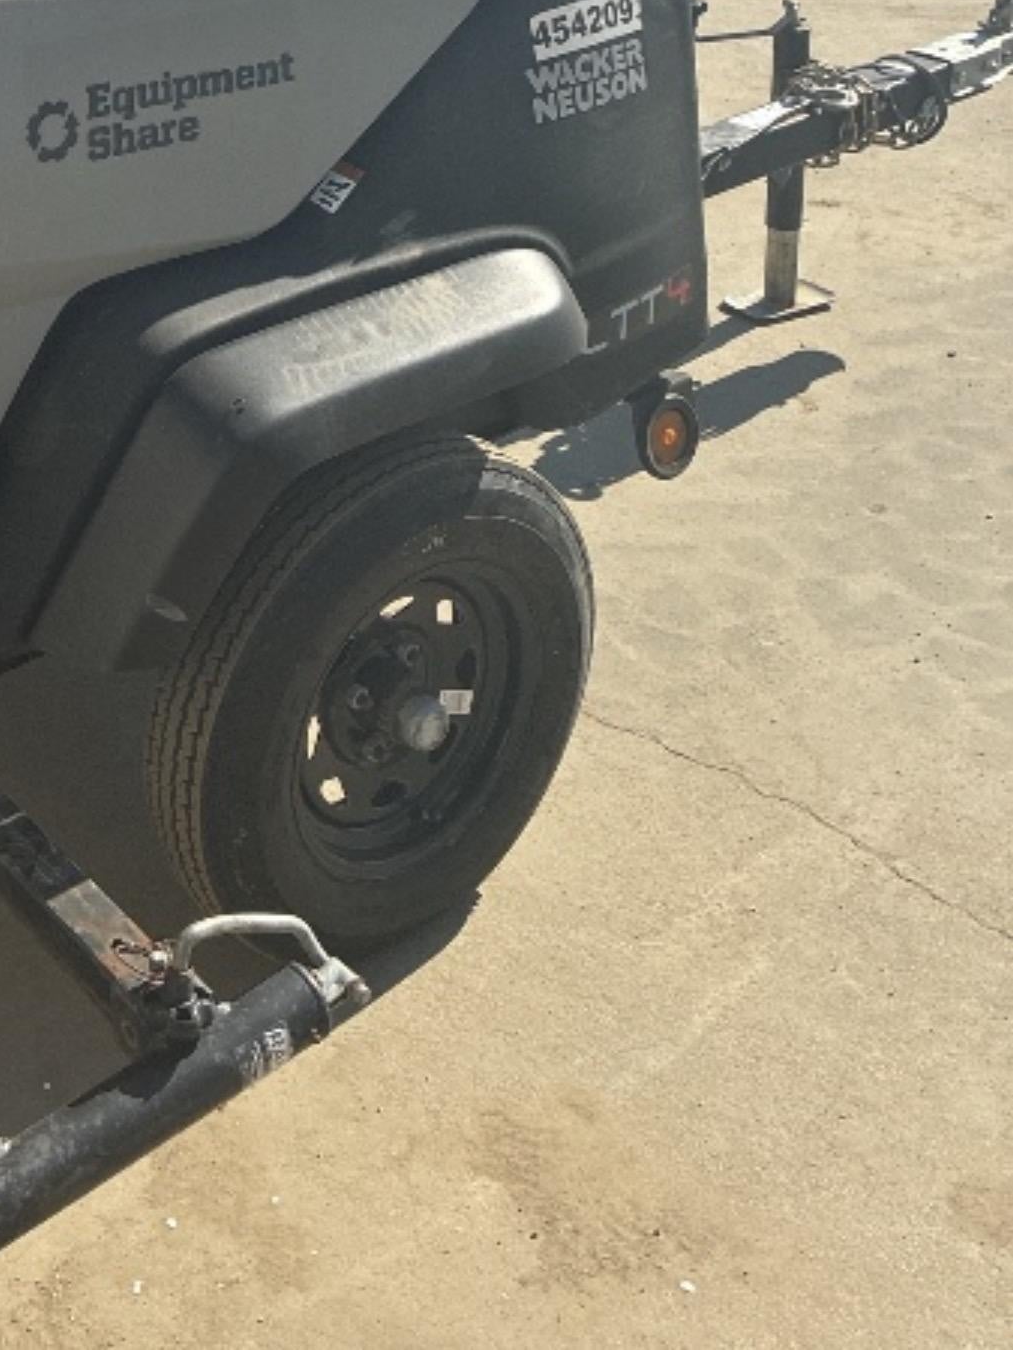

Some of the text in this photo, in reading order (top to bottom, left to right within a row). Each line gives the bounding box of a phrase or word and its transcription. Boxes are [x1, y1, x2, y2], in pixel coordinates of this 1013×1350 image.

[86, 52, 295, 120] Equipment
[525, 38, 645, 94] WACKER
[533, 66, 648, 124] NEUSON
[88, 116, 200, 162] Share
